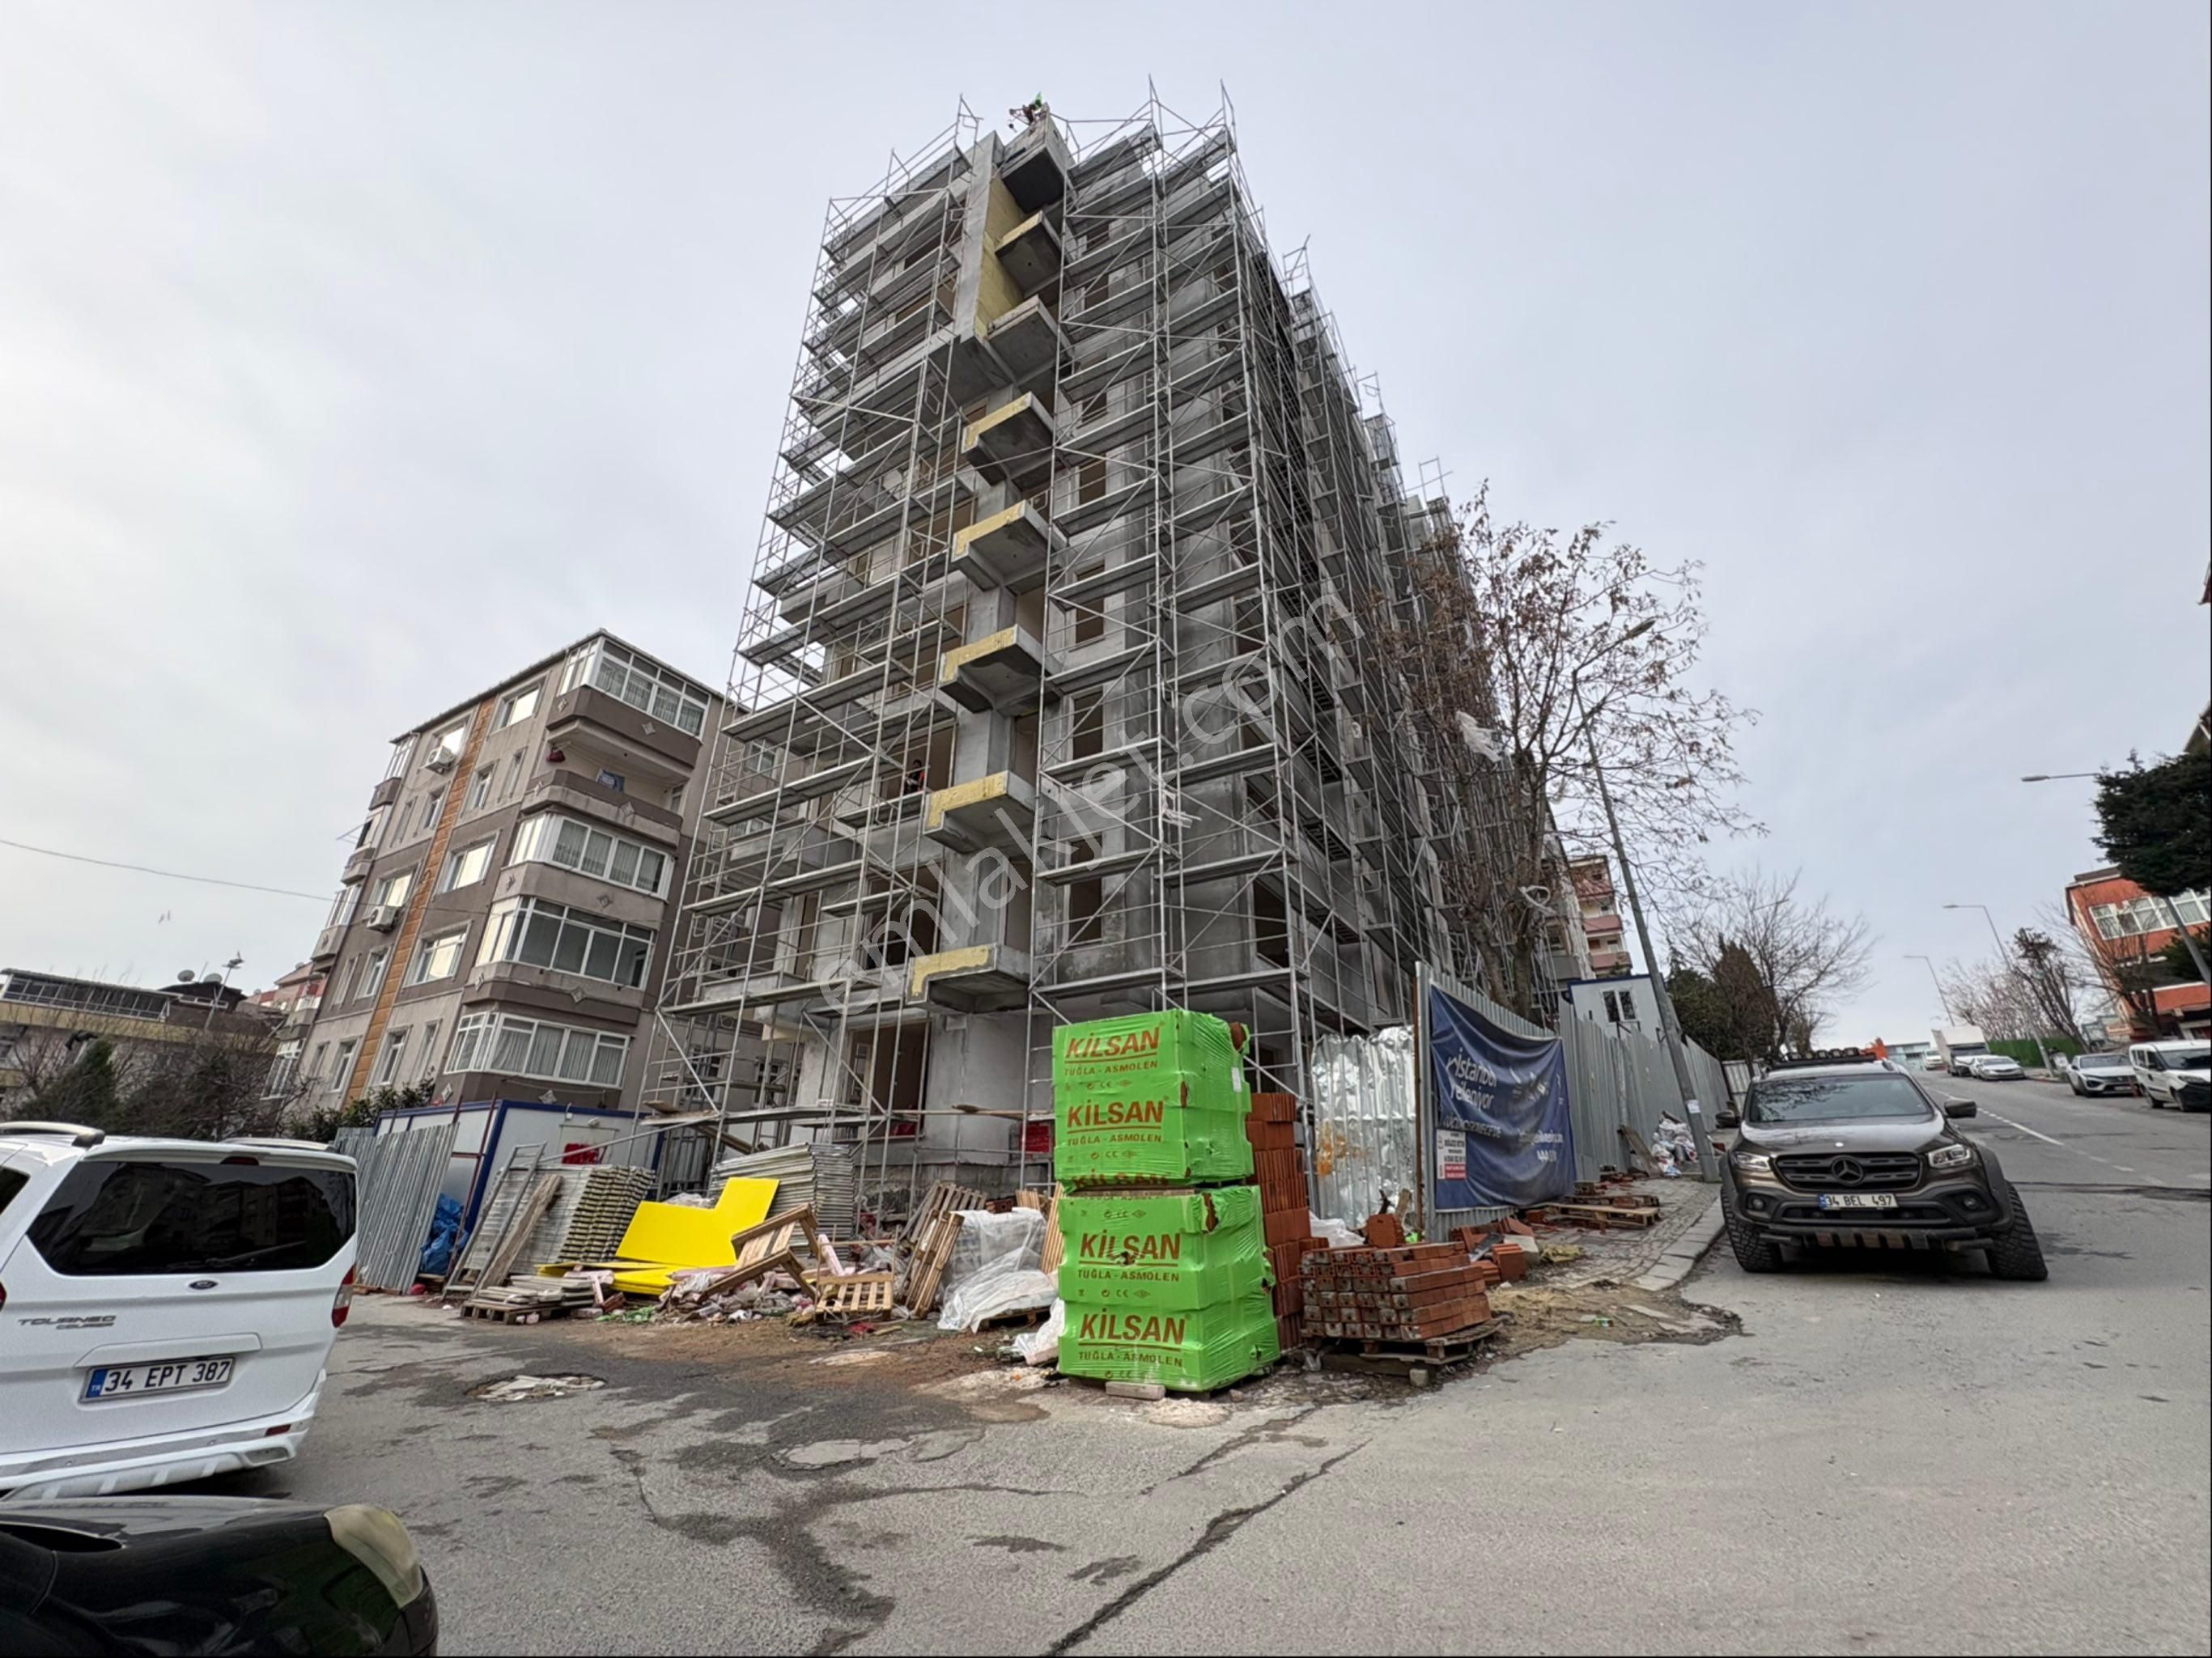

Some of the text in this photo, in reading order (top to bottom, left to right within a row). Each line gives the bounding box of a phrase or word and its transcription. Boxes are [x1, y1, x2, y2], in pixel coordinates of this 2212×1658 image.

[1065, 1026, 1160, 1058] KİLSAN
[1064, 1065, 1095, 1075] TUĞLA
[1105, 1060, 1158, 1074] ASMOLEN
[1067, 1099, 1164, 1128] KİLSAN
[1068, 1134, 1101, 1147] TUĞLA
[1110, 1133, 1162, 1143] ASMOLEN
[1844, 1195, 1866, 1206] BEL
[1872, 1195, 1892, 1206] 497
[1080, 1229, 1181, 1260] KİLSAN
[1078, 1269, 1112, 1280] TUĞLA
[1120, 1270, 1180, 1283] ASMOLEN
[18, 1315, 117, 1325] TOURNEO
[1080, 1307, 1187, 1345] KİLSAN
[1079, 1350, 1114, 1361] TUĞLA
[1123, 1352, 1183, 1368] ASMOLEN
[104, 1370, 133, 1392] 34
[144, 1365, 187, 1388] EPT
[193, 1361, 231, 1382] 387
